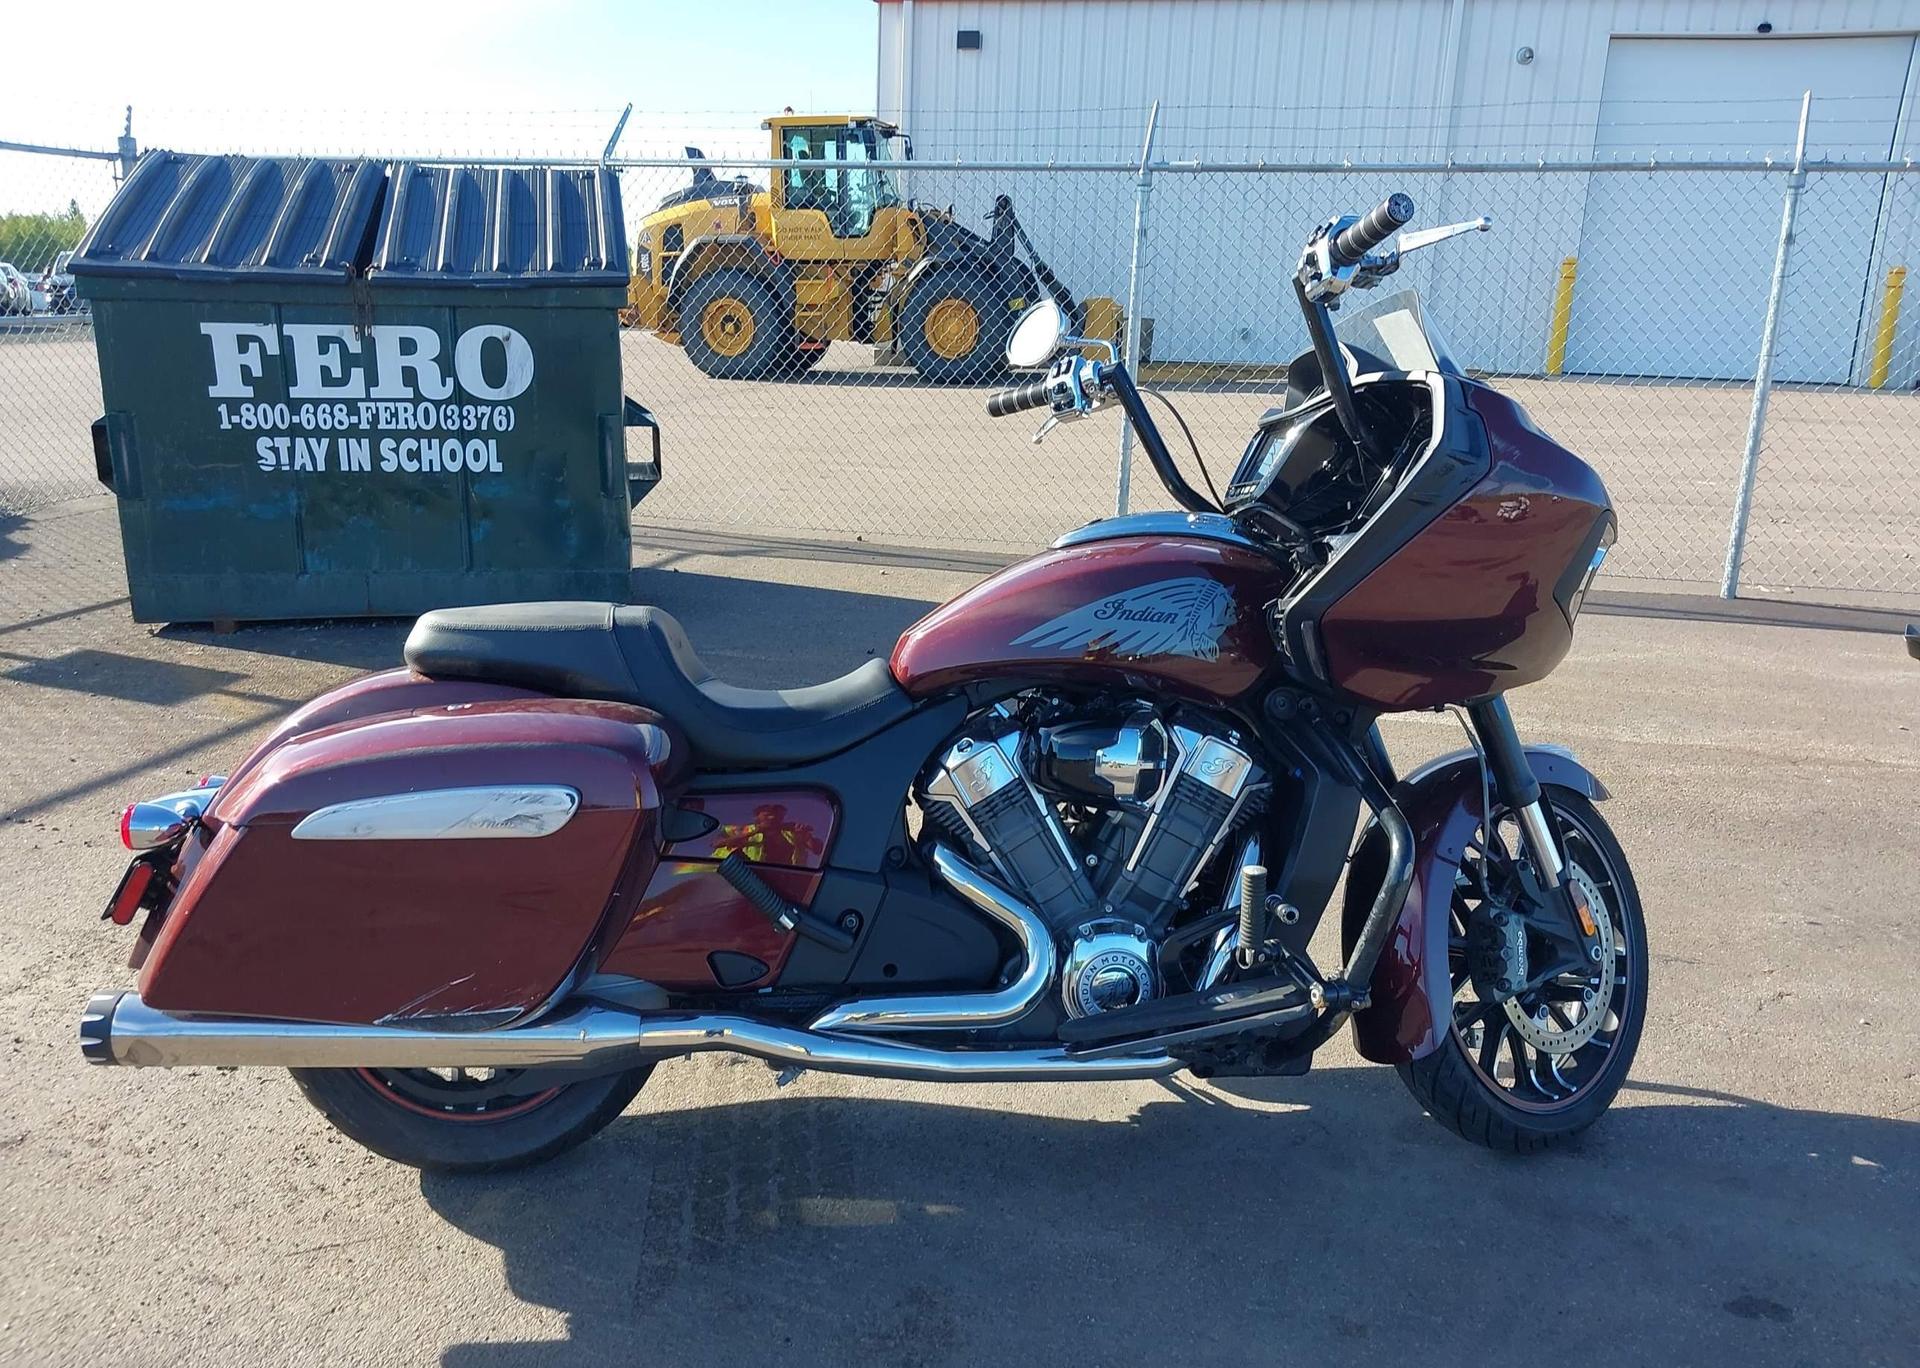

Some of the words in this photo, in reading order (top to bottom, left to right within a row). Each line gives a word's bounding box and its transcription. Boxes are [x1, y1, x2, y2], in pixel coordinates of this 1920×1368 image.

[200, 322, 535, 400] FERO
[217, 402, 515, 431] 1-800-668-FERO(3376)
[256, 436, 329, 472] STAY
[338, 438, 371, 473] IN
[380, 438, 503, 472] SCHOOL
[1094, 599, 1179, 625] Indian
[1082, 965, 1098, 1012] INDIAN
[1101, 955, 1149, 1000] MOTORCYC
